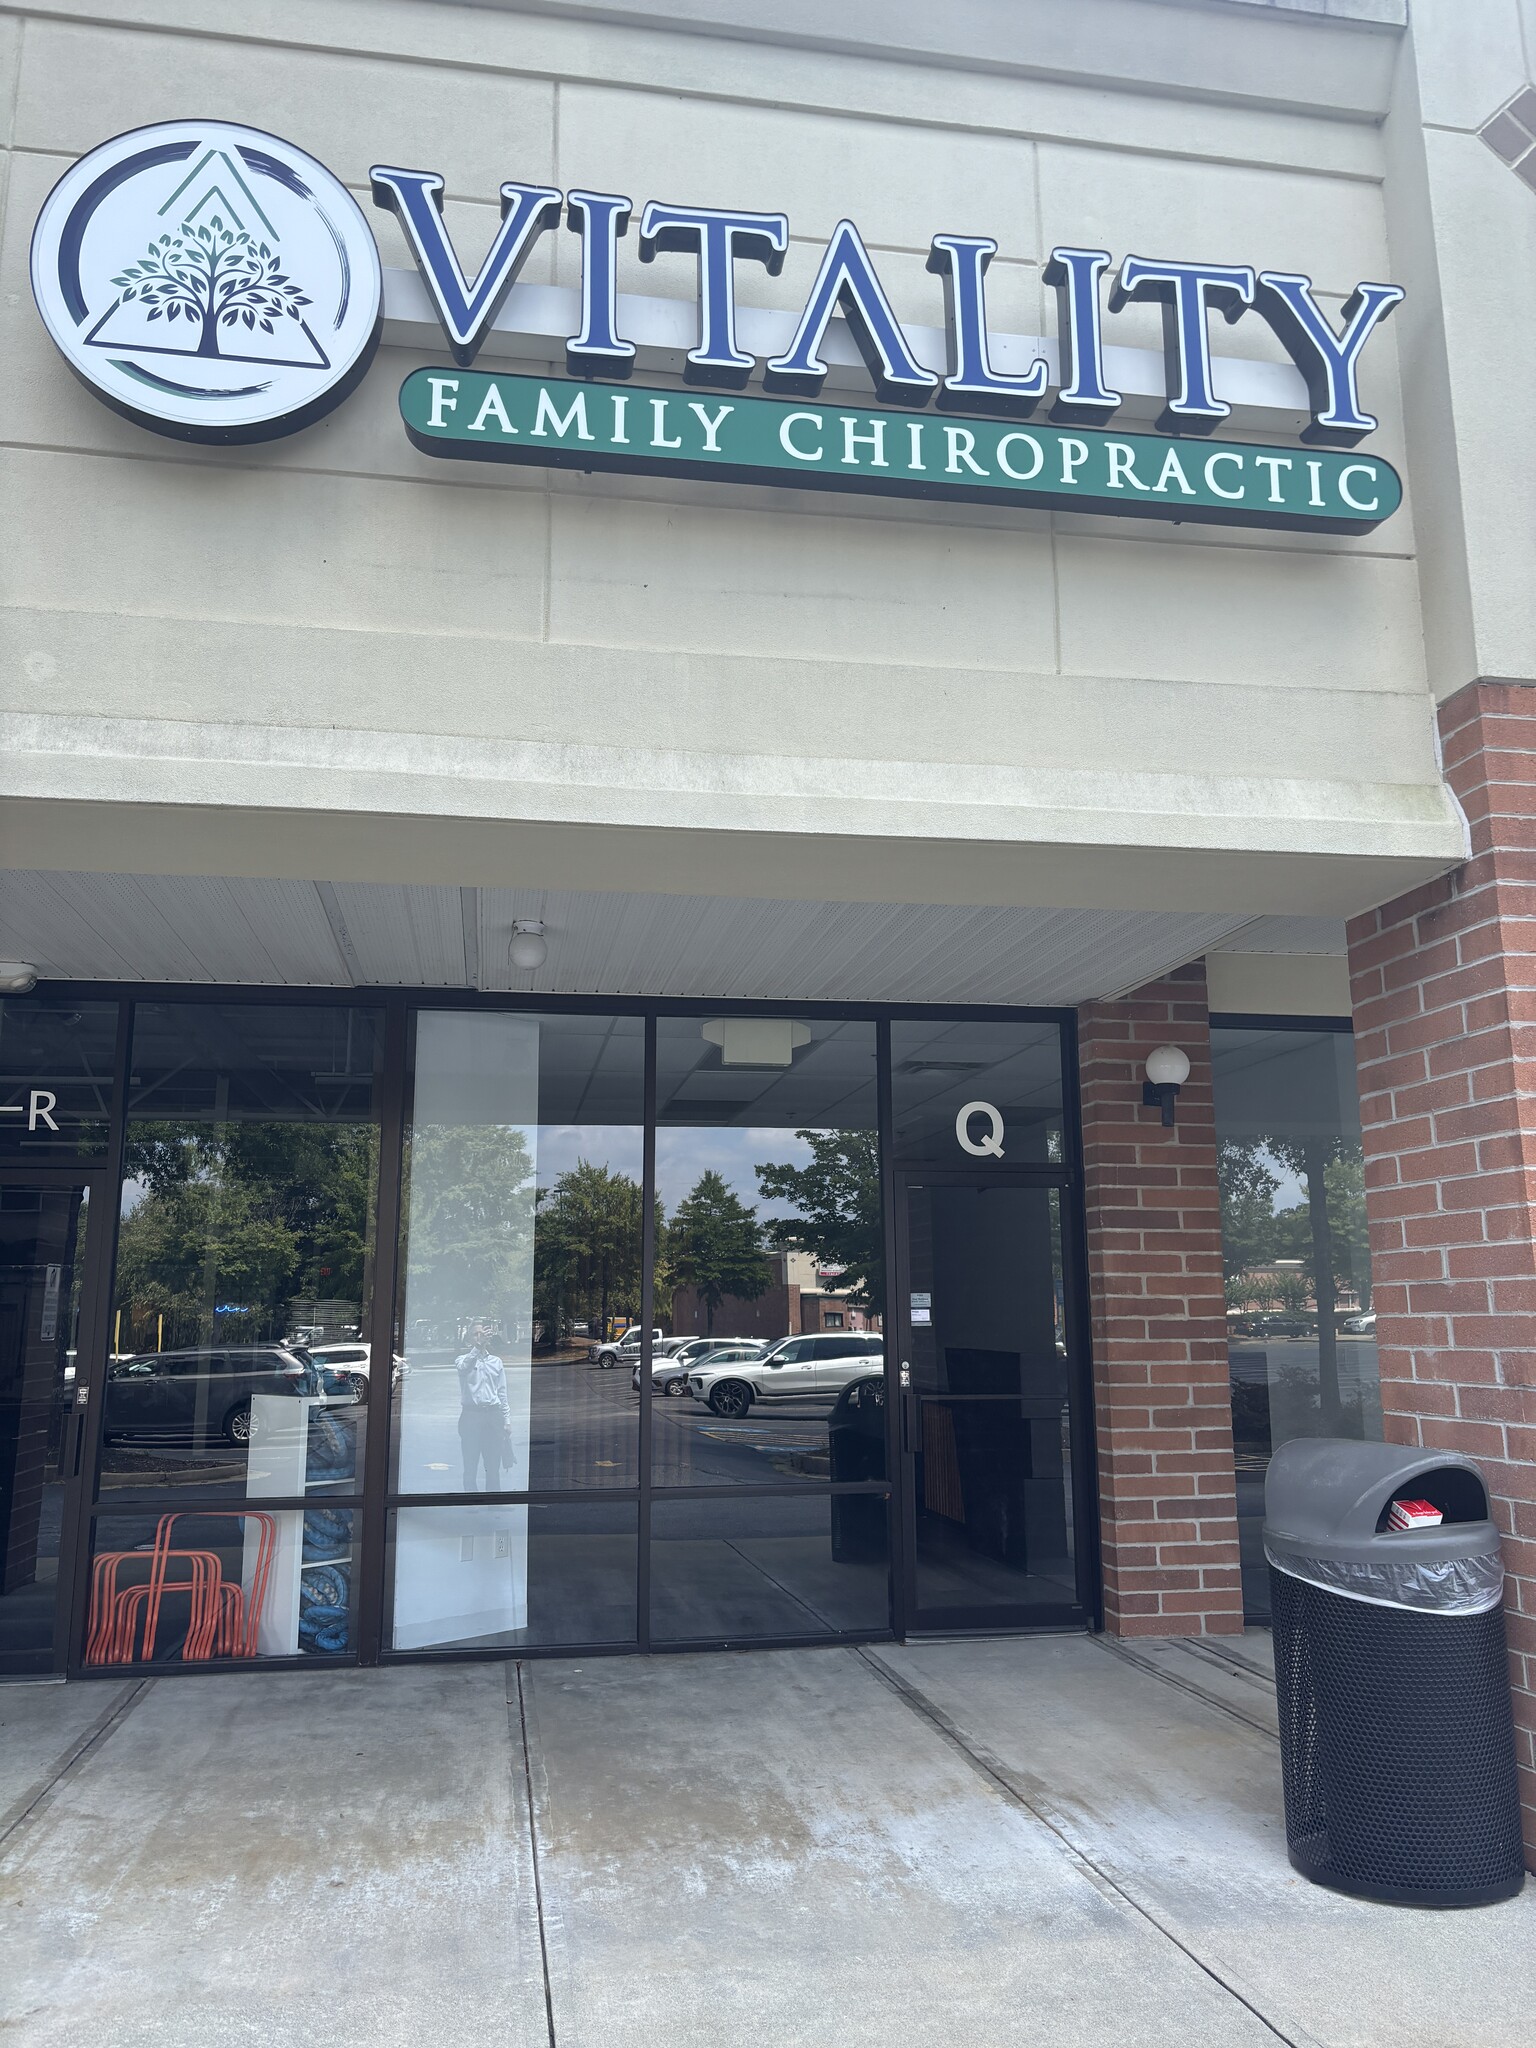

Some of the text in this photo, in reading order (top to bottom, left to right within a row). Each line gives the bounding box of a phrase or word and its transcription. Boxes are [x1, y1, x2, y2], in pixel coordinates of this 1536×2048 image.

[369, 164, 1405, 432] VITALITY
[426, 377, 1380, 513] FAMILY CHIROPRACTIC
[955, 1101, 1006, 1159] Q
